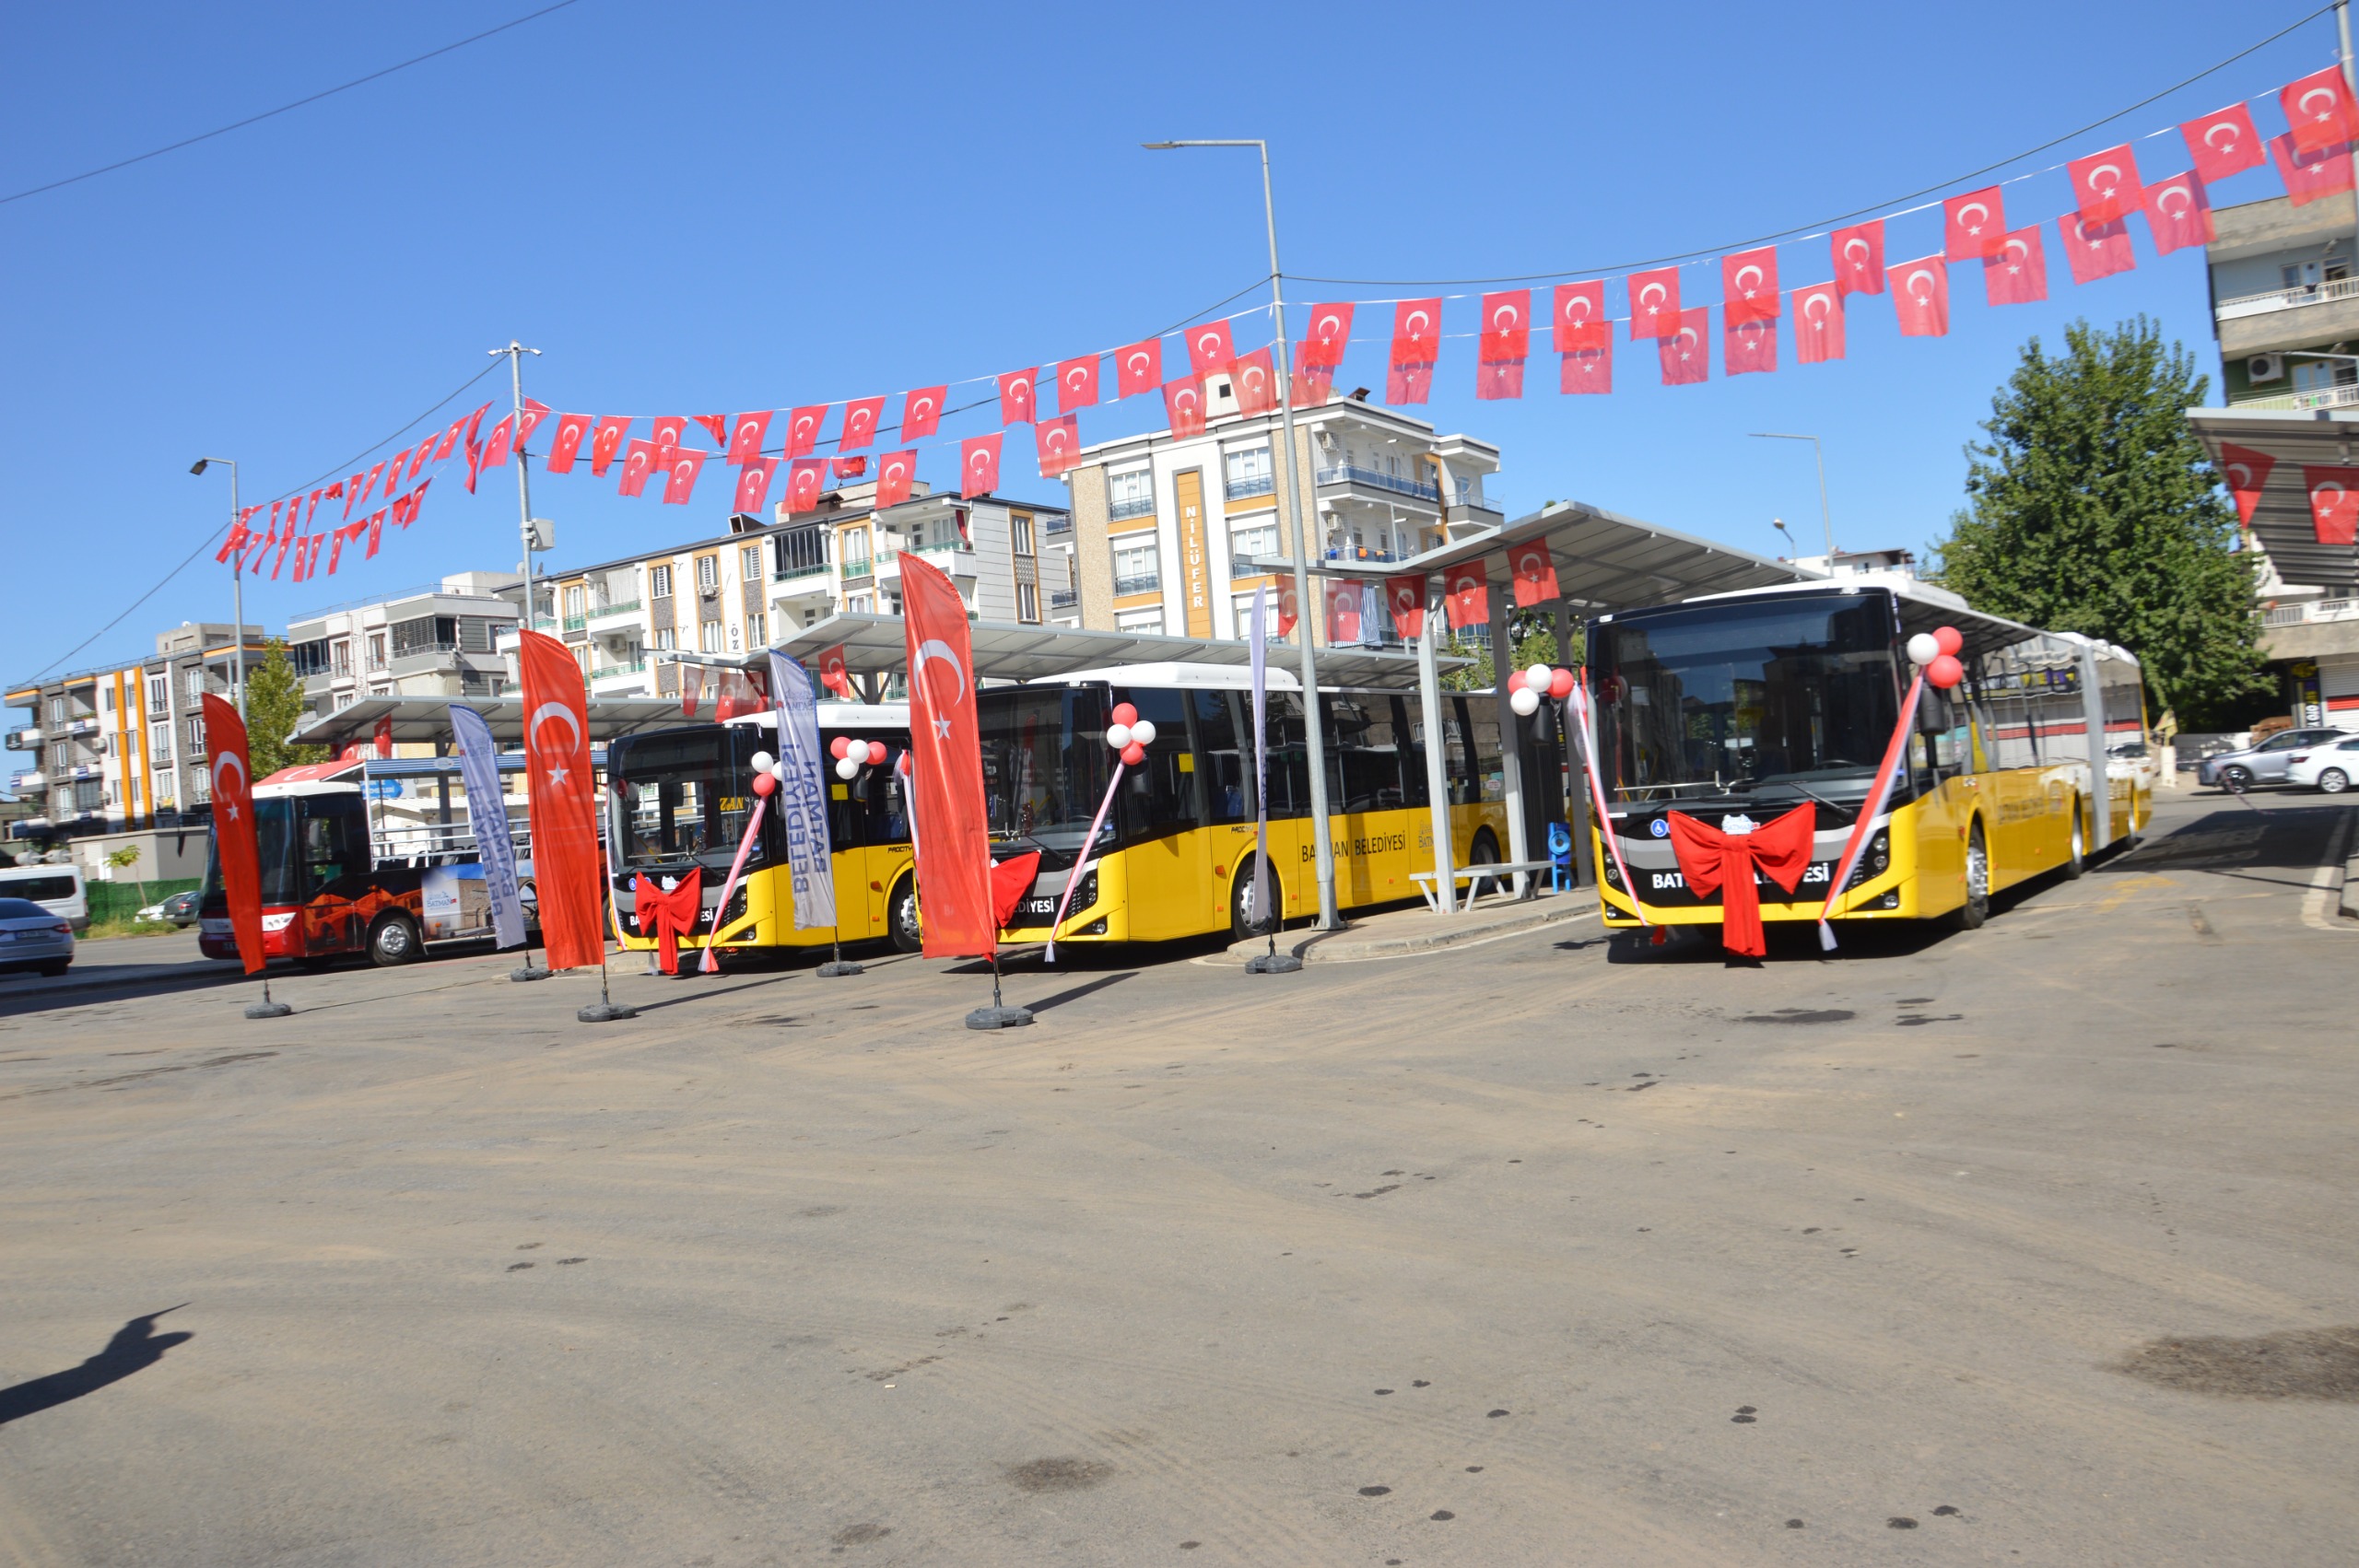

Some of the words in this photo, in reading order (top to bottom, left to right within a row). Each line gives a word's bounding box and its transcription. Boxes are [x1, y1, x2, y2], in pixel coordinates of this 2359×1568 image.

[1186, 506, 1203, 608] NİLÜFER
[1302, 840, 1348, 862] BAAN
[1355, 830, 1406, 856] BELEDİYESİ
[1418, 836, 1435, 848] BATM
[1652, 872, 1684, 889] BAT
[1017, 896, 1054, 913] DİYESİ
